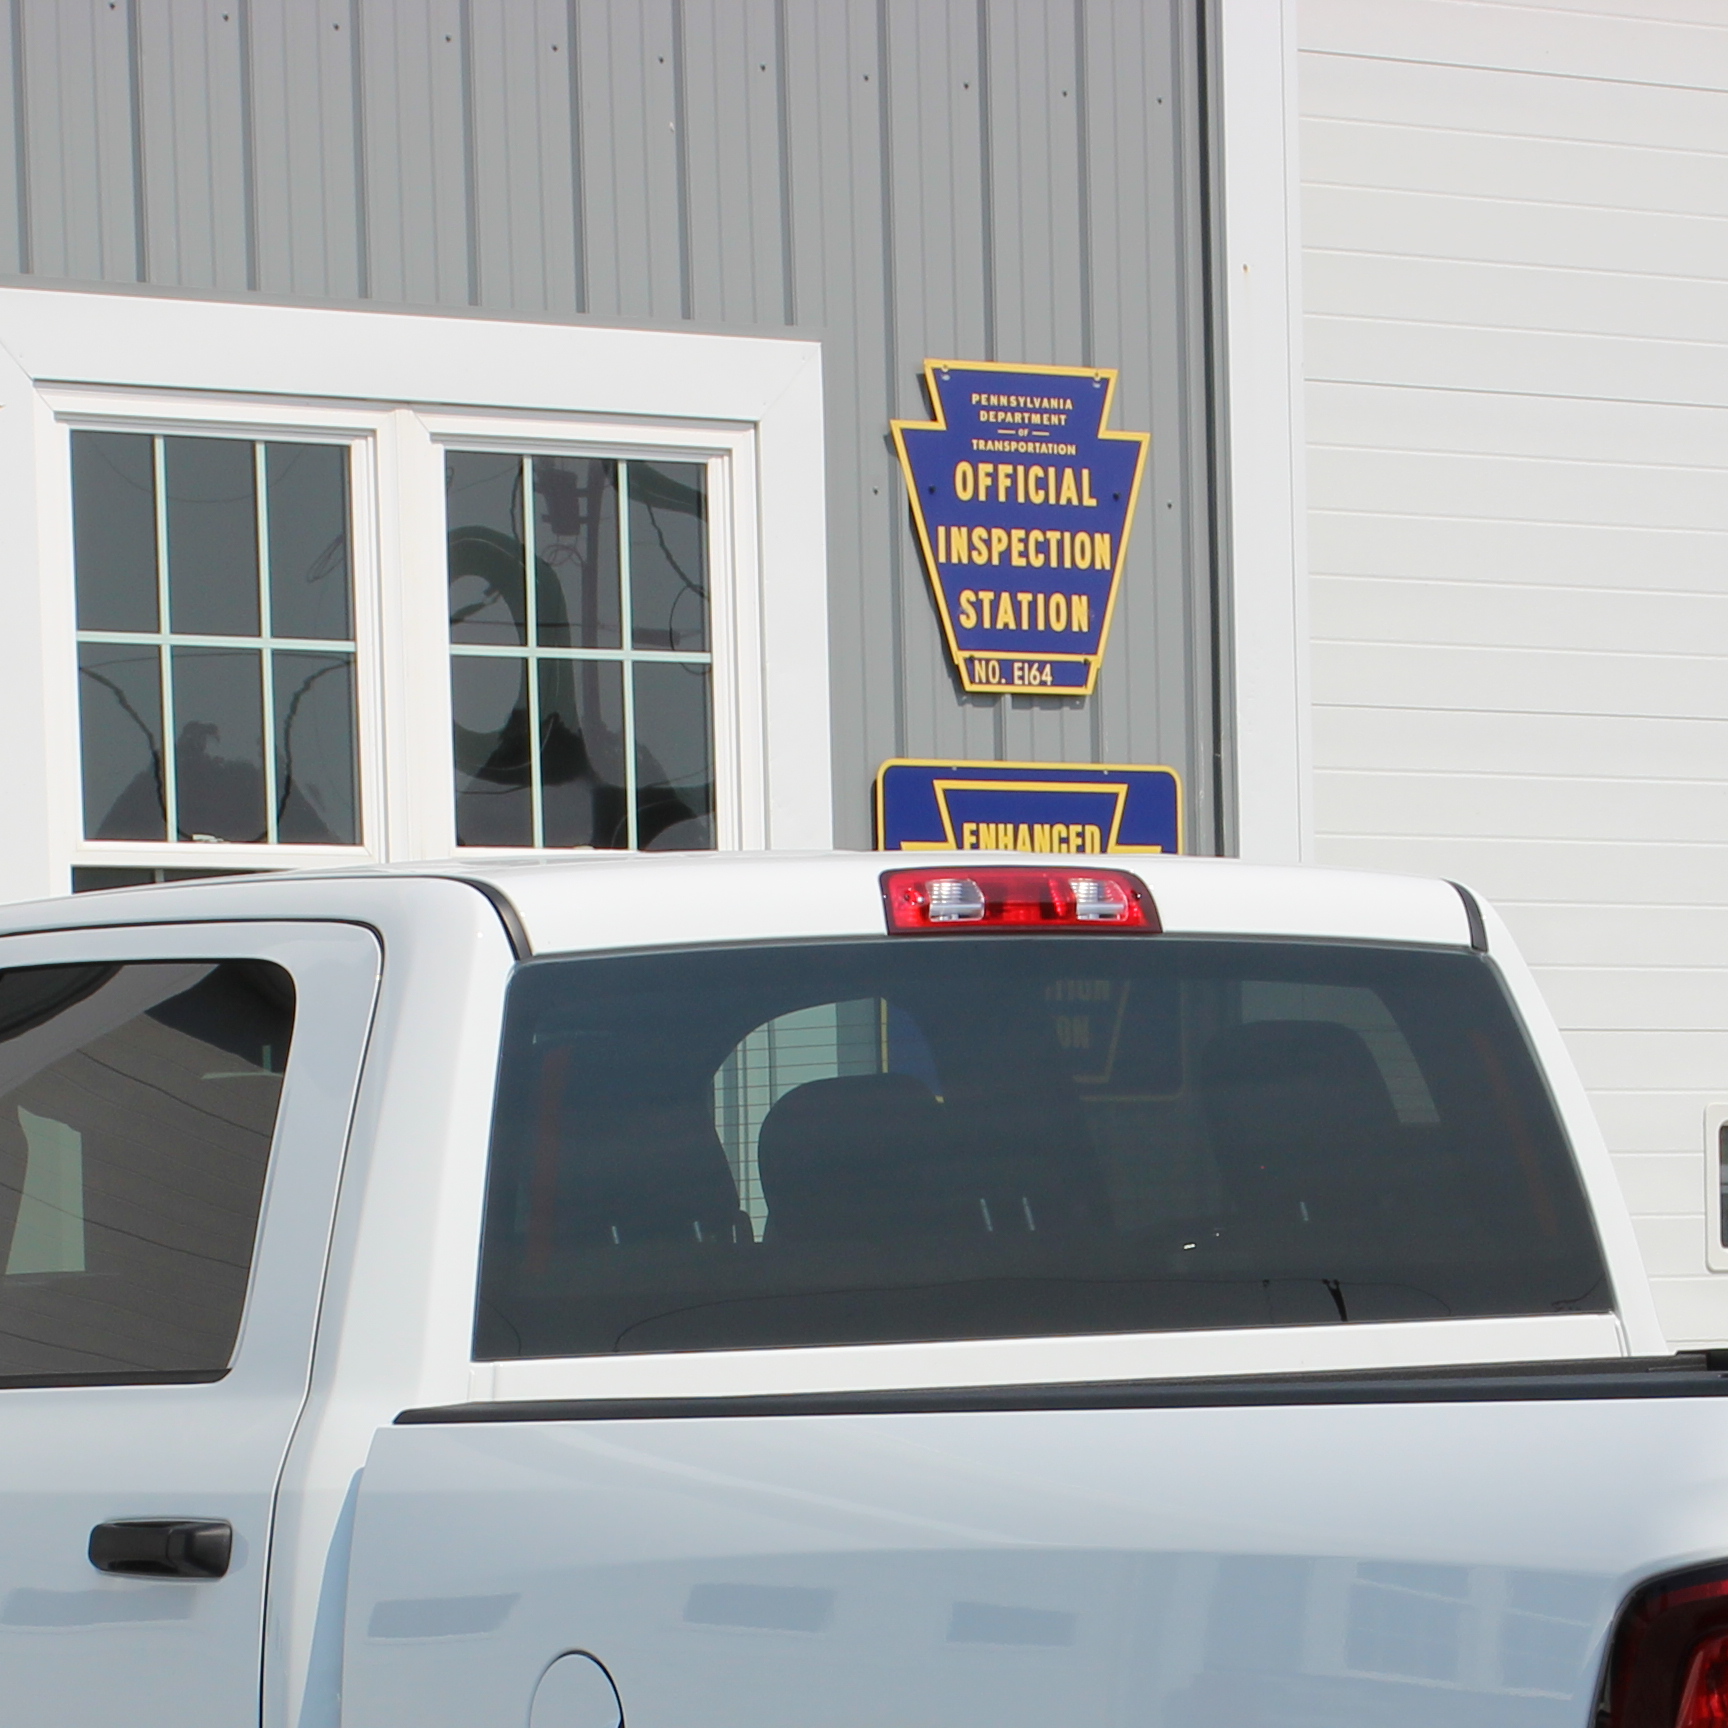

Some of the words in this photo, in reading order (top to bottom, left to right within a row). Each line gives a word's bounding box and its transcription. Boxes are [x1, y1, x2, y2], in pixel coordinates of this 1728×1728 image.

[971, 392, 1074, 410] PENNSYLVANIA
[979, 409, 1067, 426] DEPARTMENT
[1017, 427, 1030, 437] OF
[971, 438, 1077, 456] TRANSPORTATION
[954, 460, 1098, 507] OFFICIAL
[937, 525, 1112, 571] INSPECTION
[958, 589, 1089, 633] STATION
[973, 660, 1006, 684] NO.
[962, 821, 1102, 854] ENHANCED
